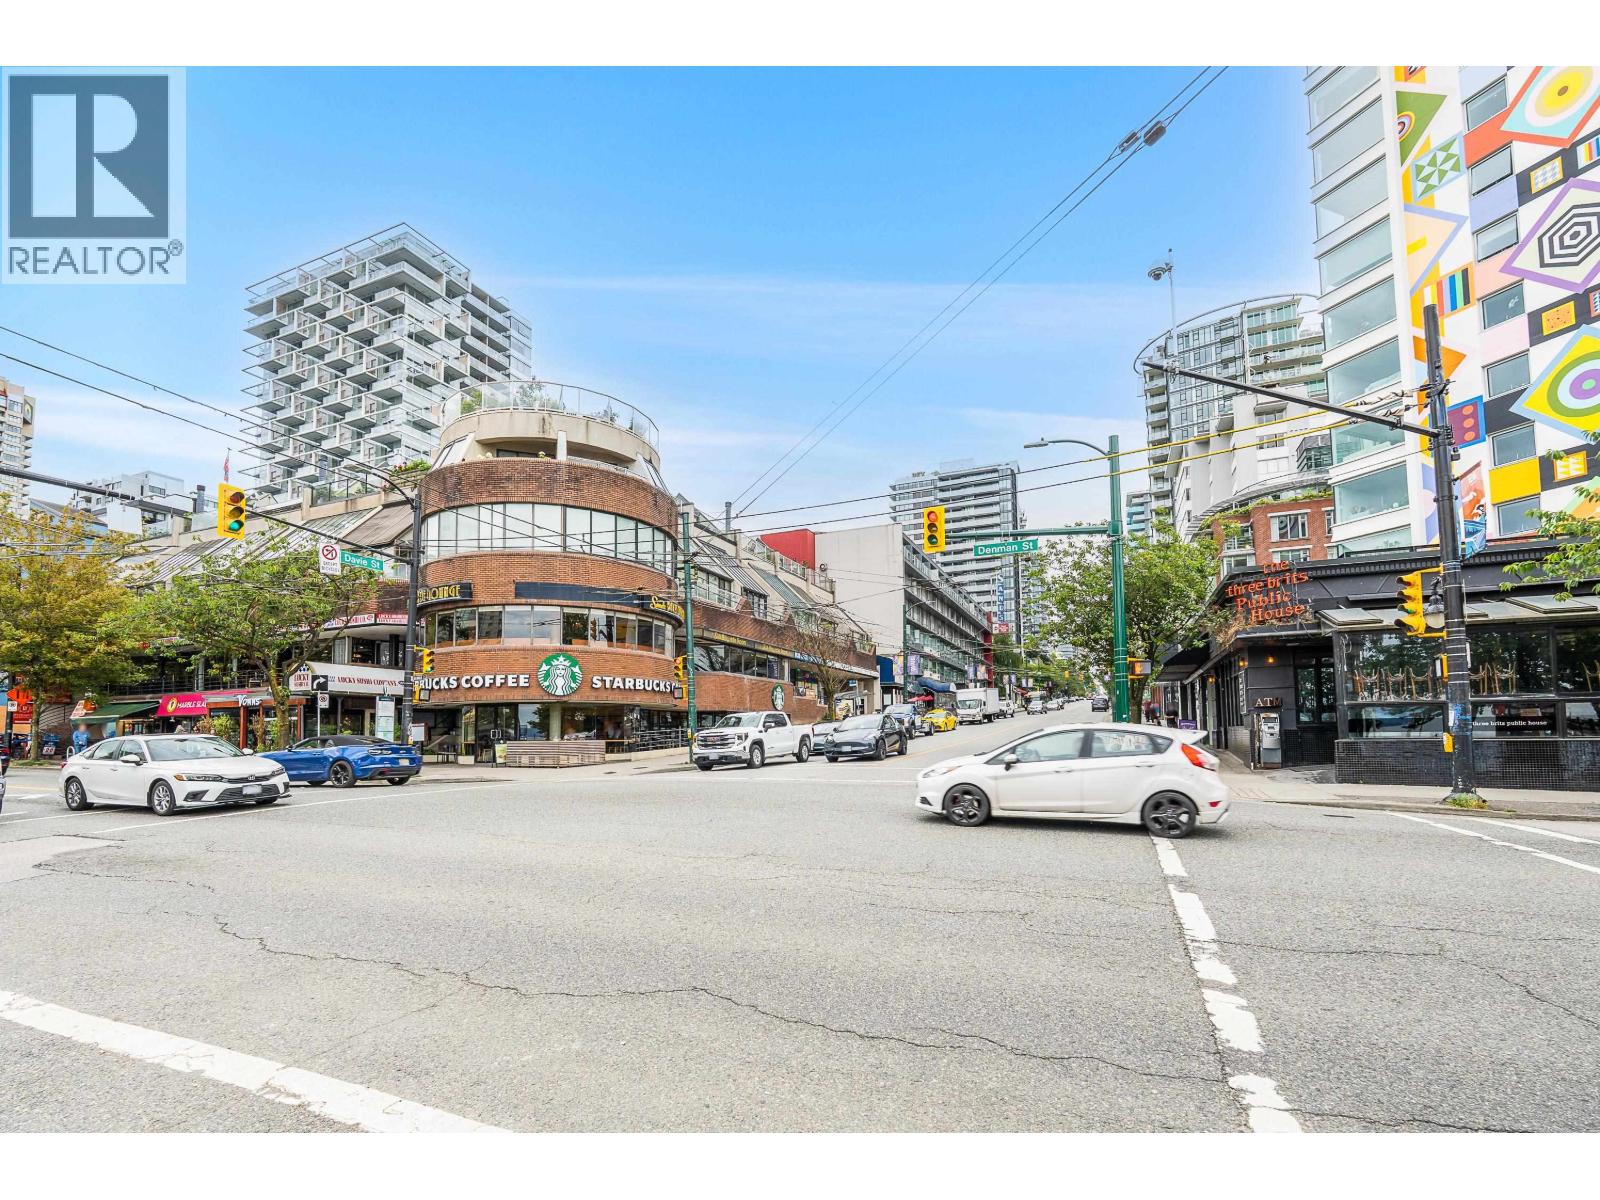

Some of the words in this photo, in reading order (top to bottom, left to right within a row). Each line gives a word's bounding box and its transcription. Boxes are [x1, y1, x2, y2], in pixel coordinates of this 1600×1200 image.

[977, 544, 1018, 555] Denman
[1022, 541, 1034, 551] St
[344, 553, 368, 566] Davie
[370, 560, 380, 569] St
[1263, 560, 1289, 574] the
[1225, 581, 1264, 597] three
[1267, 571, 1309, 589] brits
[1235, 590, 1293, 610] Public
[1250, 604, 1305, 625] House
[337, 676, 356, 684] LUCKY
[461, 674, 530, 688] COFFEE
[592, 675, 671, 692] STARBUCKS
[1255, 697, 1282, 707] ATM
